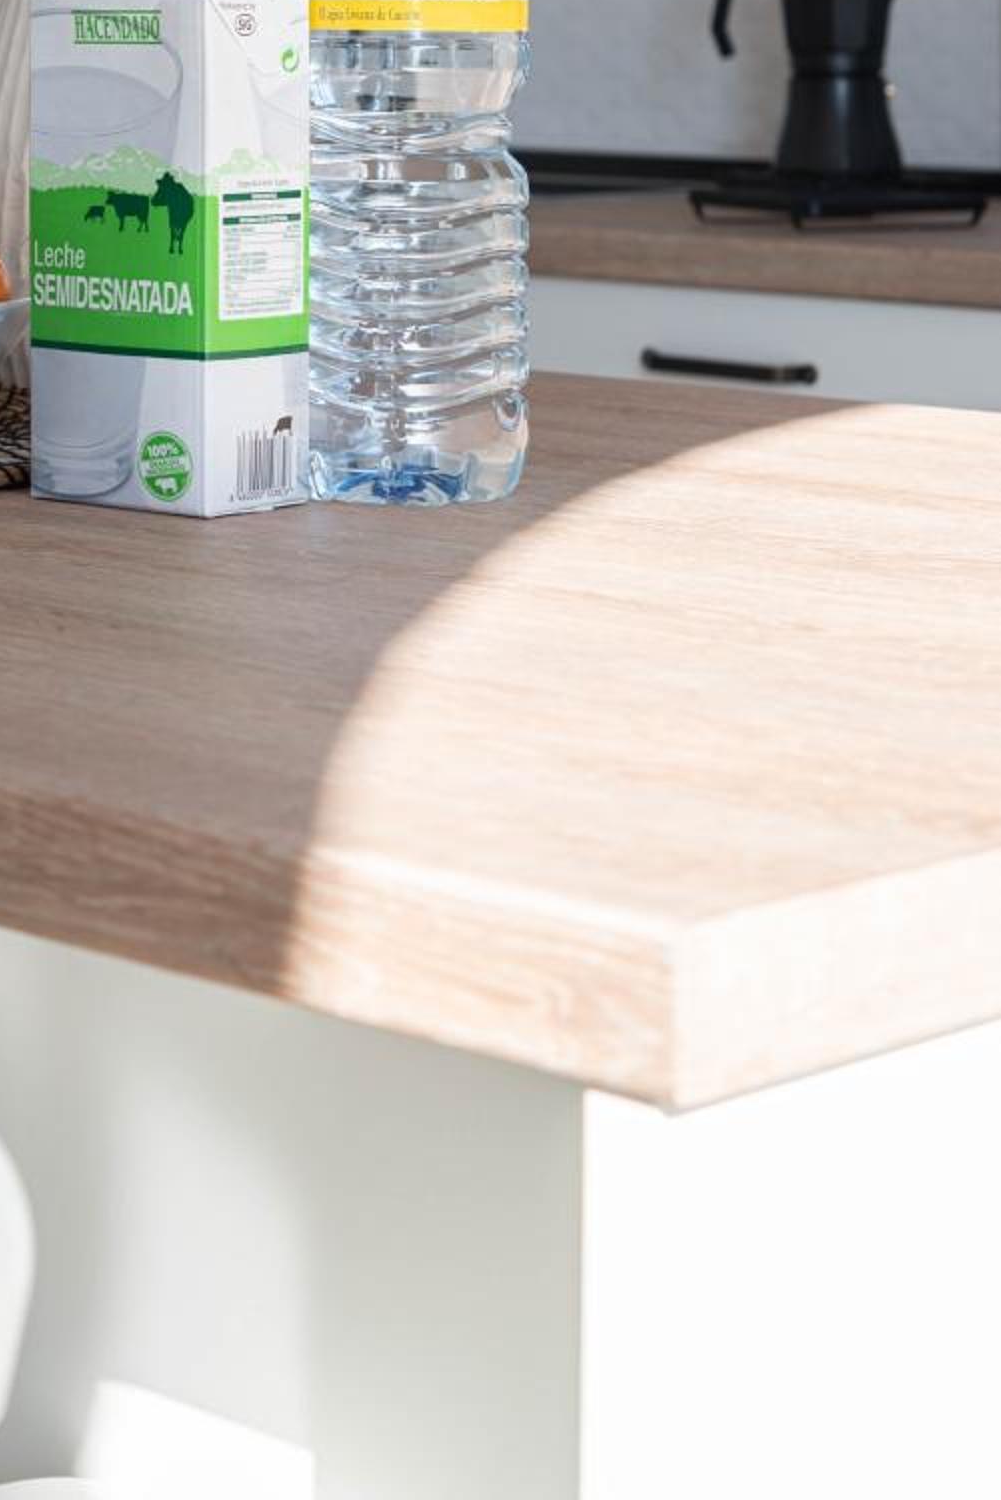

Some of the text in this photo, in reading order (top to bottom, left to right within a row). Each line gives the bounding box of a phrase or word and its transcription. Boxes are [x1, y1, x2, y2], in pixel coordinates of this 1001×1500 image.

[74, 15, 160, 40] HACENDADO
[33, 240, 86, 269] Leche
[32, 272, 194, 317] SEMIDESNATADA
